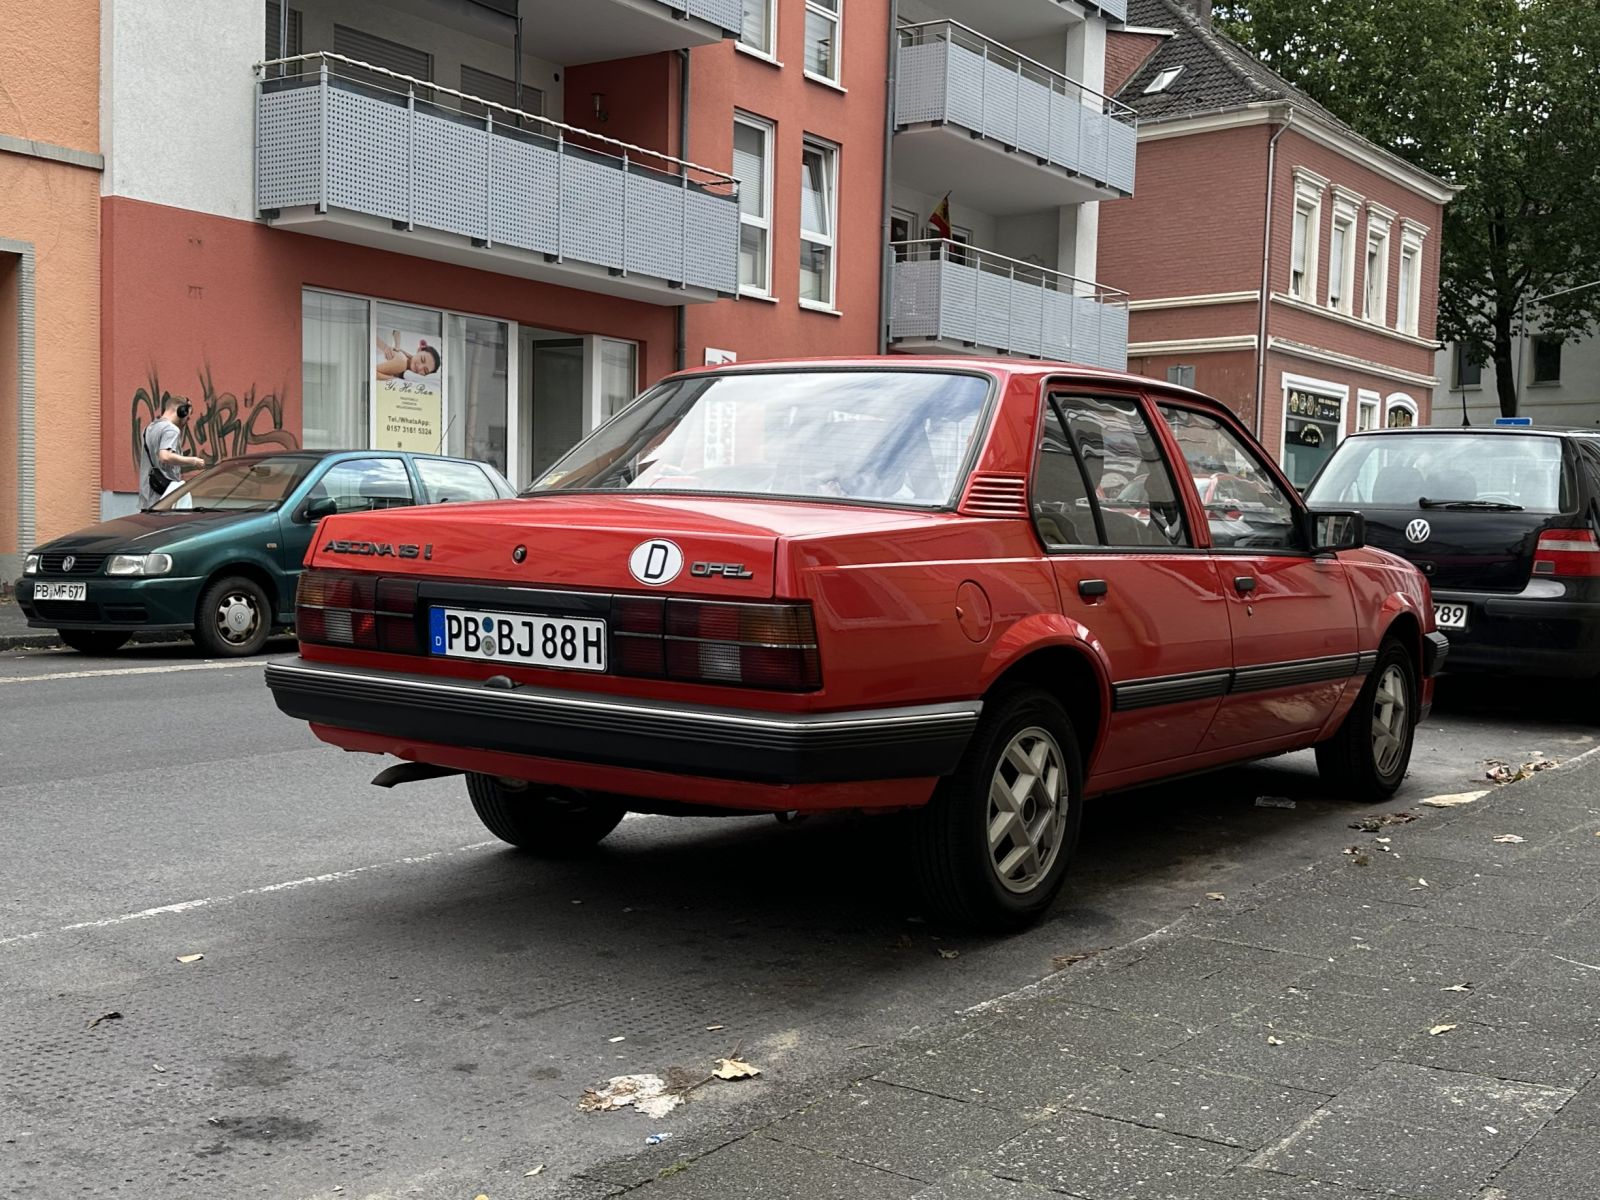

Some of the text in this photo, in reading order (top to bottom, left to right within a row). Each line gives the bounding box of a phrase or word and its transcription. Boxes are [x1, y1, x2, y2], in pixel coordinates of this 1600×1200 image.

[386, 425, 401, 433] 0157
[322, 540, 396, 557] ASCONA
[644, 544, 669, 579] D
[690, 560, 753, 579] OPEL
[35, 584, 49, 598] PB
[68, 585, 84, 598] 677
[435, 636, 442, 646] D
[446, 614, 481, 652] PB
[497, 619, 534, 657] BJ
